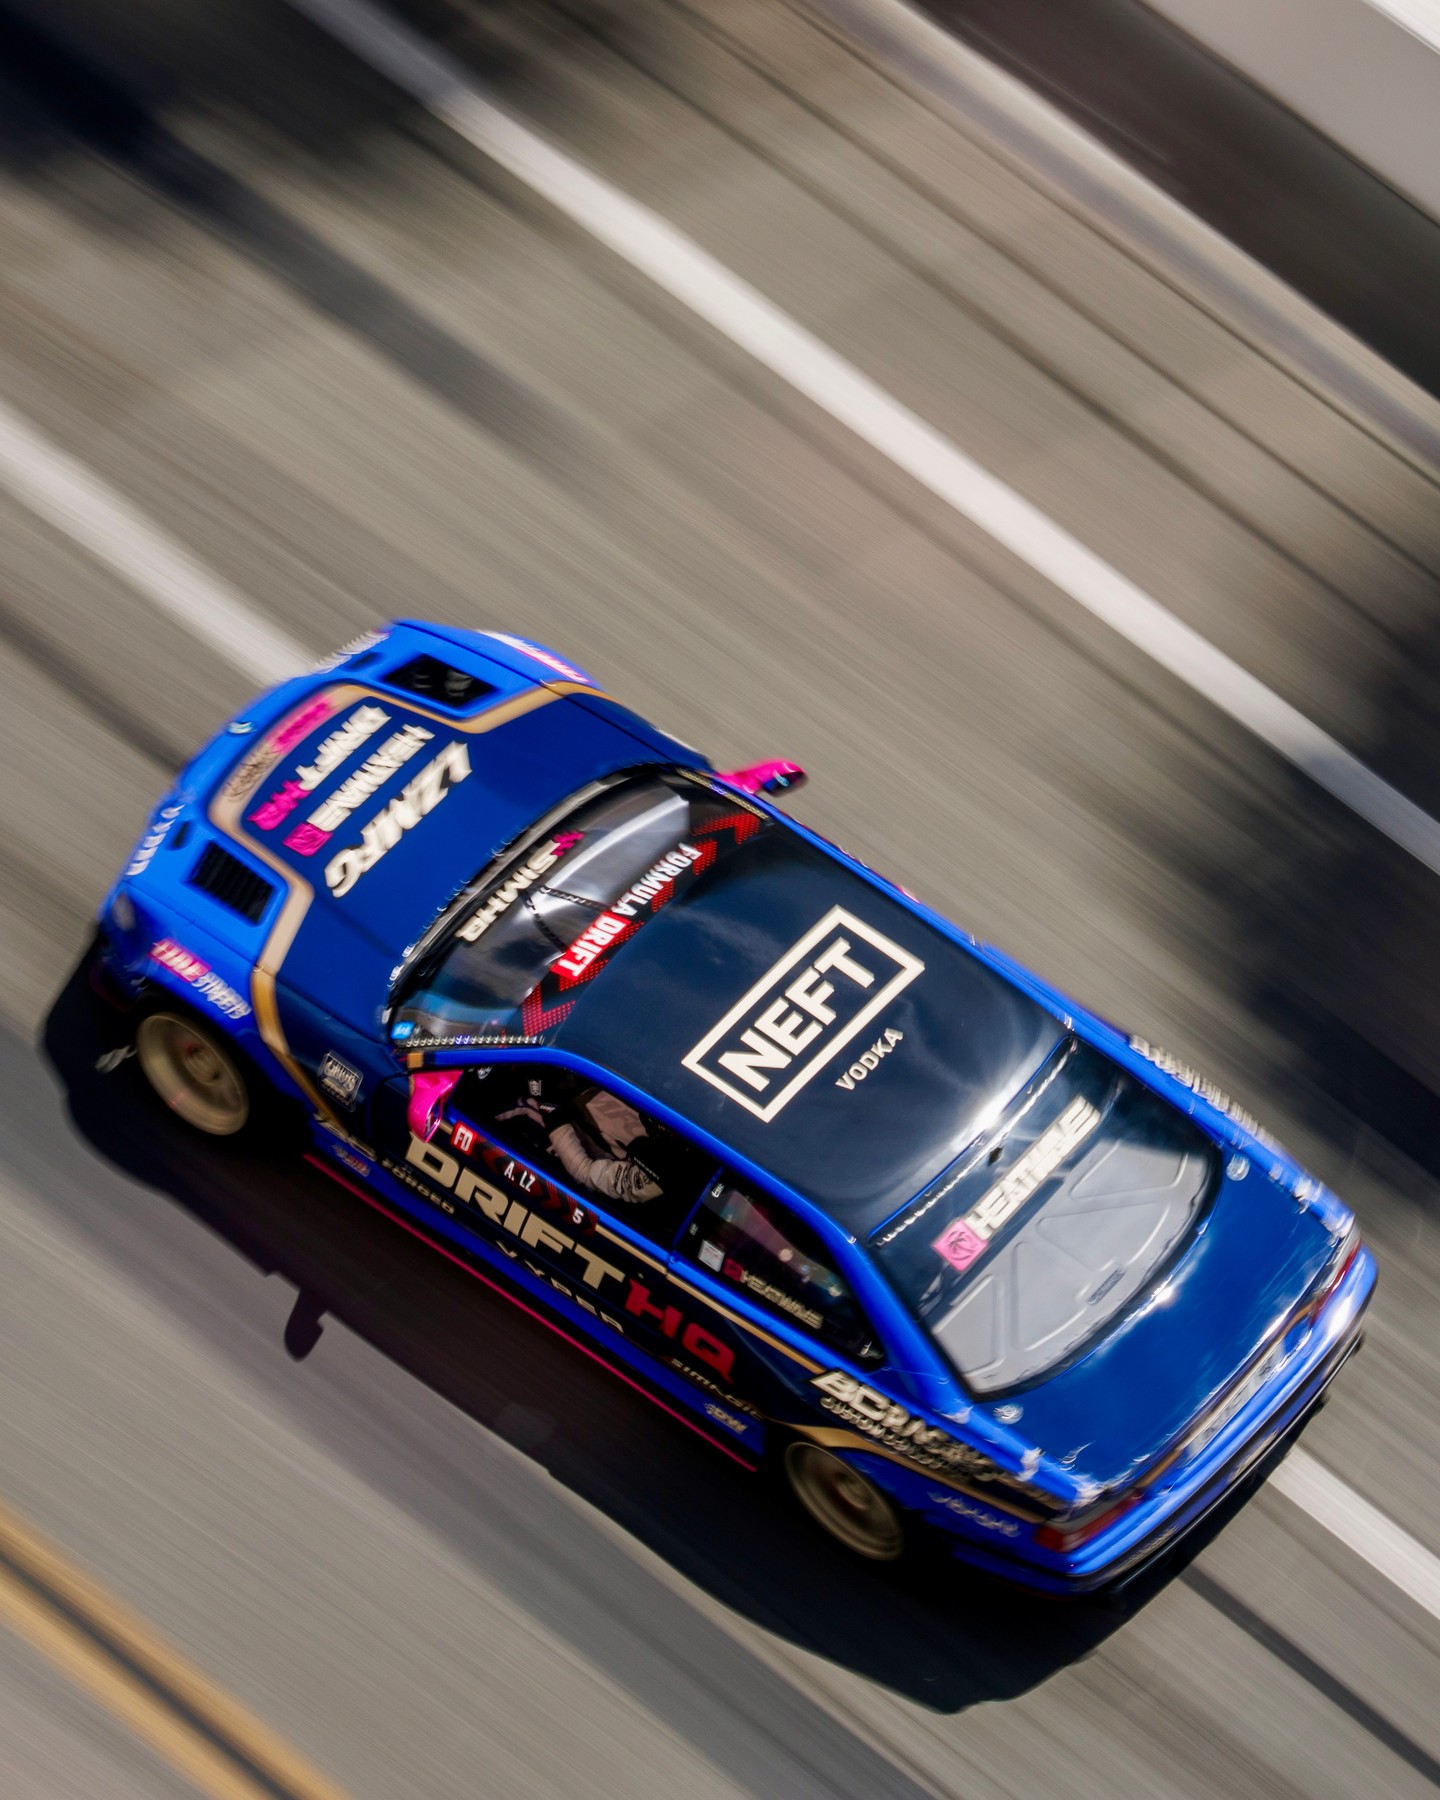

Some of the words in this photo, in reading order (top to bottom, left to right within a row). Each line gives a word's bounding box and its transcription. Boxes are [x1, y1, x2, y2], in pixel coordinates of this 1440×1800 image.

[610, 842, 703, 919] FORMULA
[557, 911, 631, 977] DRIFT
[718, 936, 875, 1092] NEFT
[835, 1027, 904, 1091] VODKA
[453, 1125, 474, 1153] FD
[963, 1096, 1101, 1240] HEATWAVE
[504, 1161, 516, 1182] A.
[519, 1170, 536, 1192] LZ
[572, 1208, 585, 1225] 5
[496, 1240, 625, 1334] VYPER
